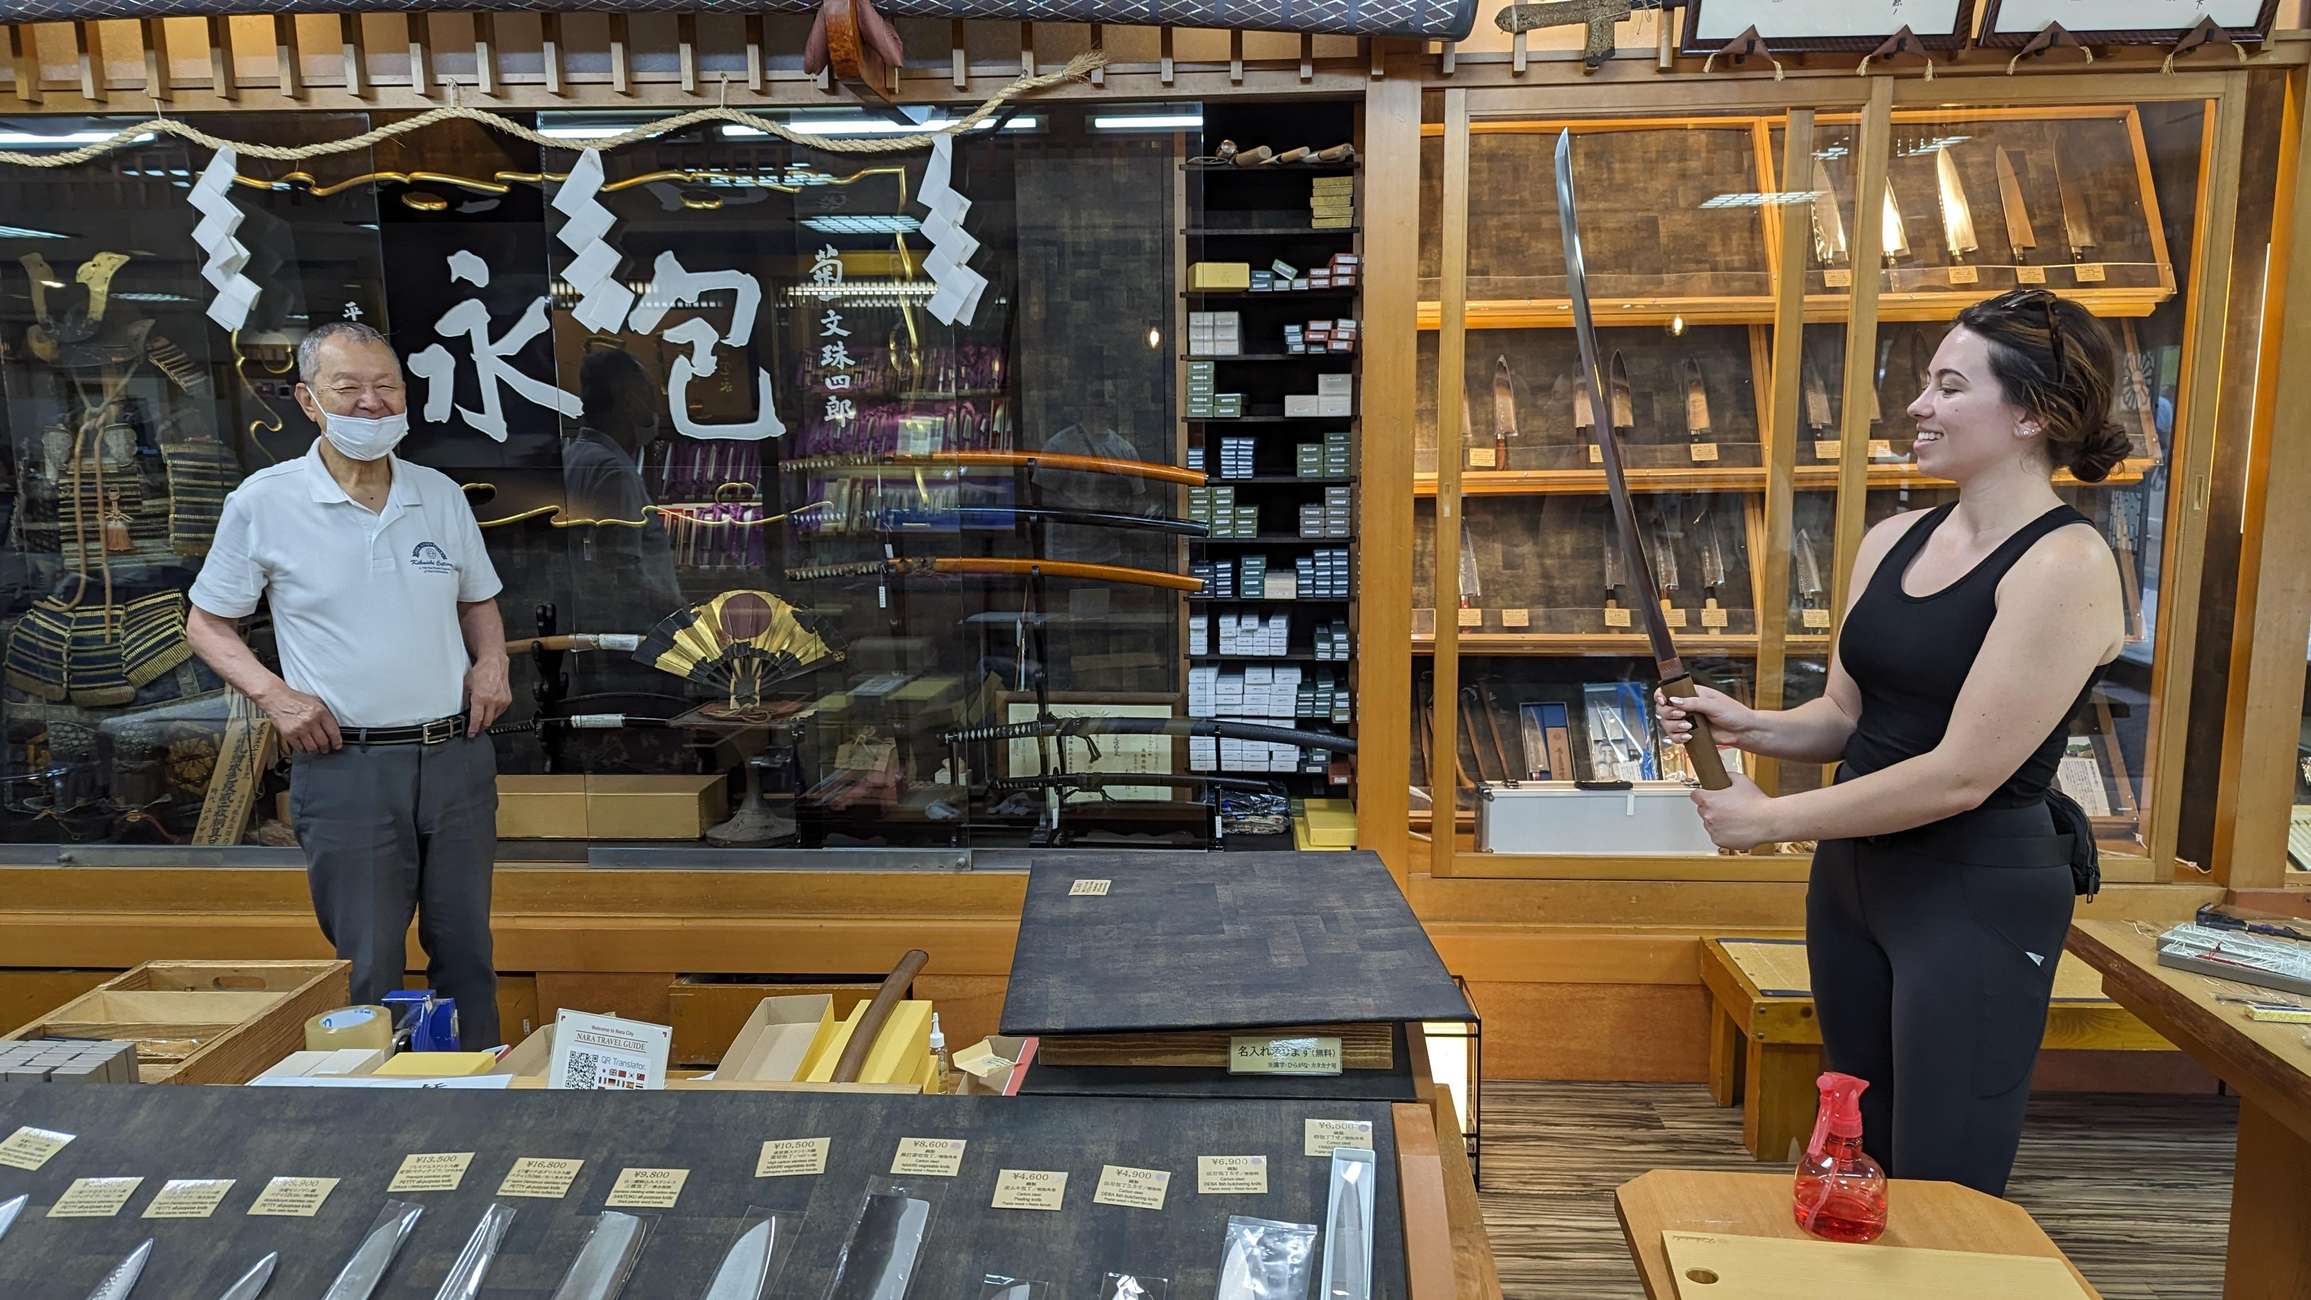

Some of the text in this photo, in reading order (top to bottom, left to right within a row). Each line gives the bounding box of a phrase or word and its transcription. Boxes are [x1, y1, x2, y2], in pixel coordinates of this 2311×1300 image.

[576, 1032, 646, 1051] NARA TRAVEL GUIDE
[601, 1055, 612, 1065] QR
